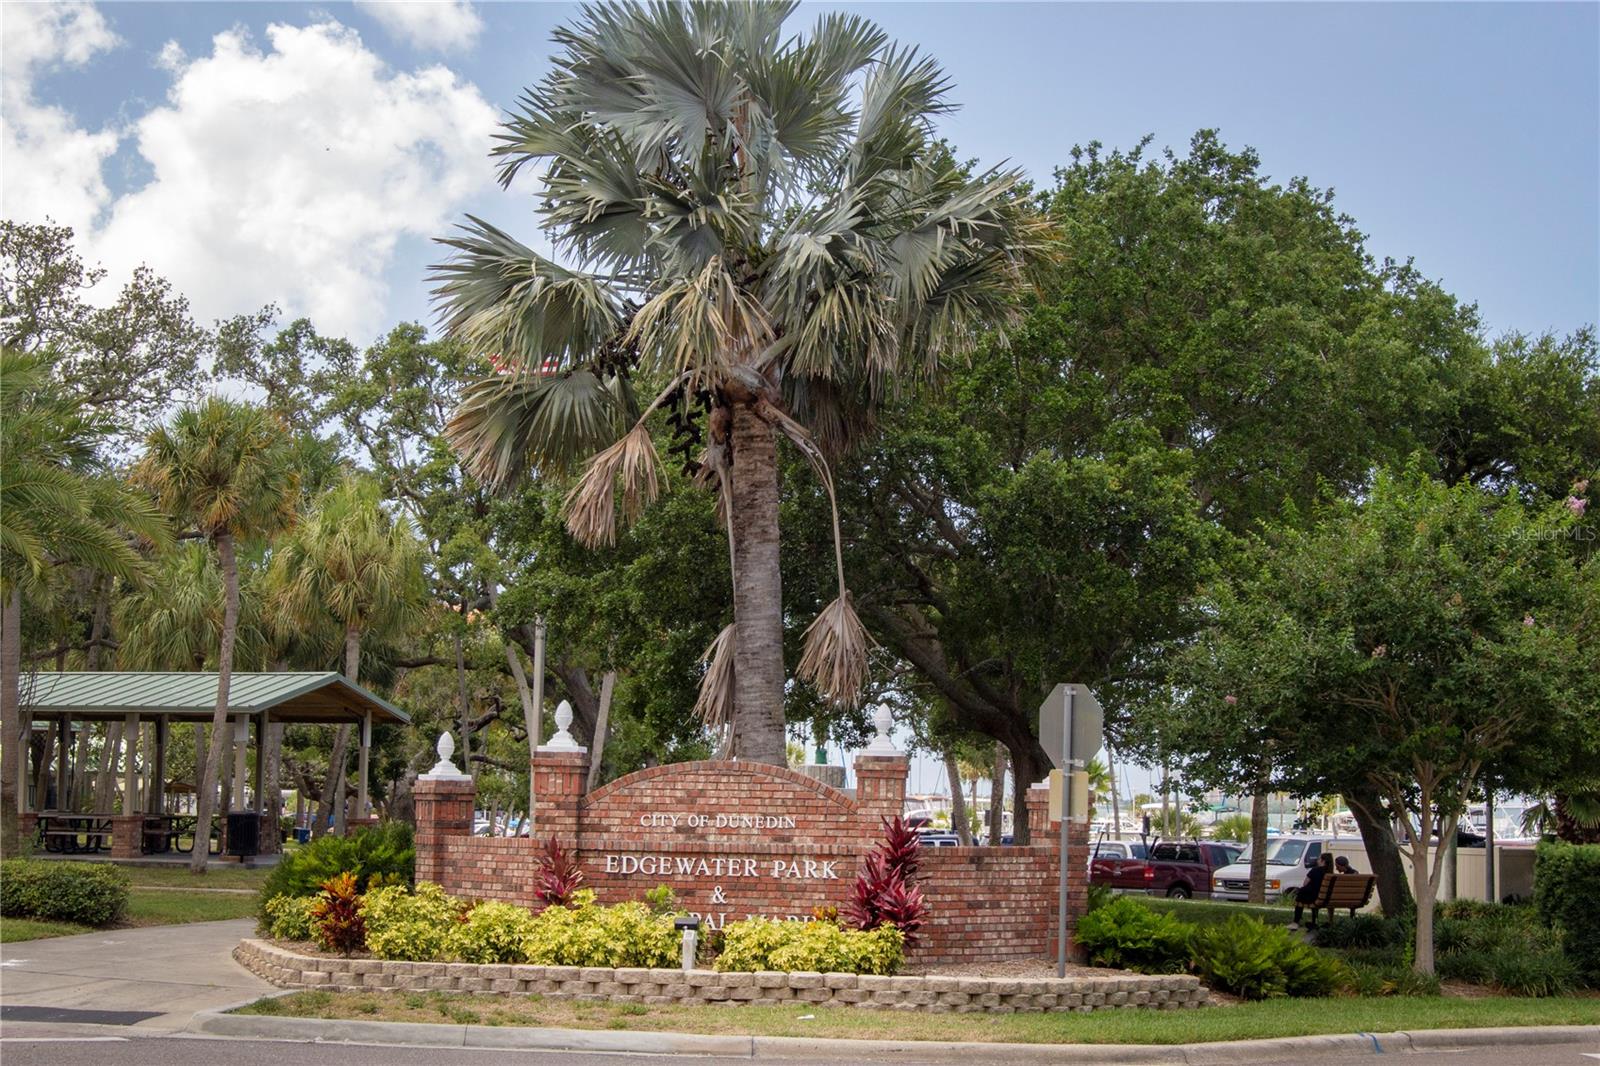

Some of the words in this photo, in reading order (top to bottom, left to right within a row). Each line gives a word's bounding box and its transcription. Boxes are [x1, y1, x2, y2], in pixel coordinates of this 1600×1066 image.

[640, 814, 680, 827] CITY
[687, 814, 710, 828] OF
[716, 815, 797, 829] DUNEDIN
[605, 855, 759, 877] EDGEWATER
[772, 859, 839, 880] PARK
[712, 885, 728, 904] &
